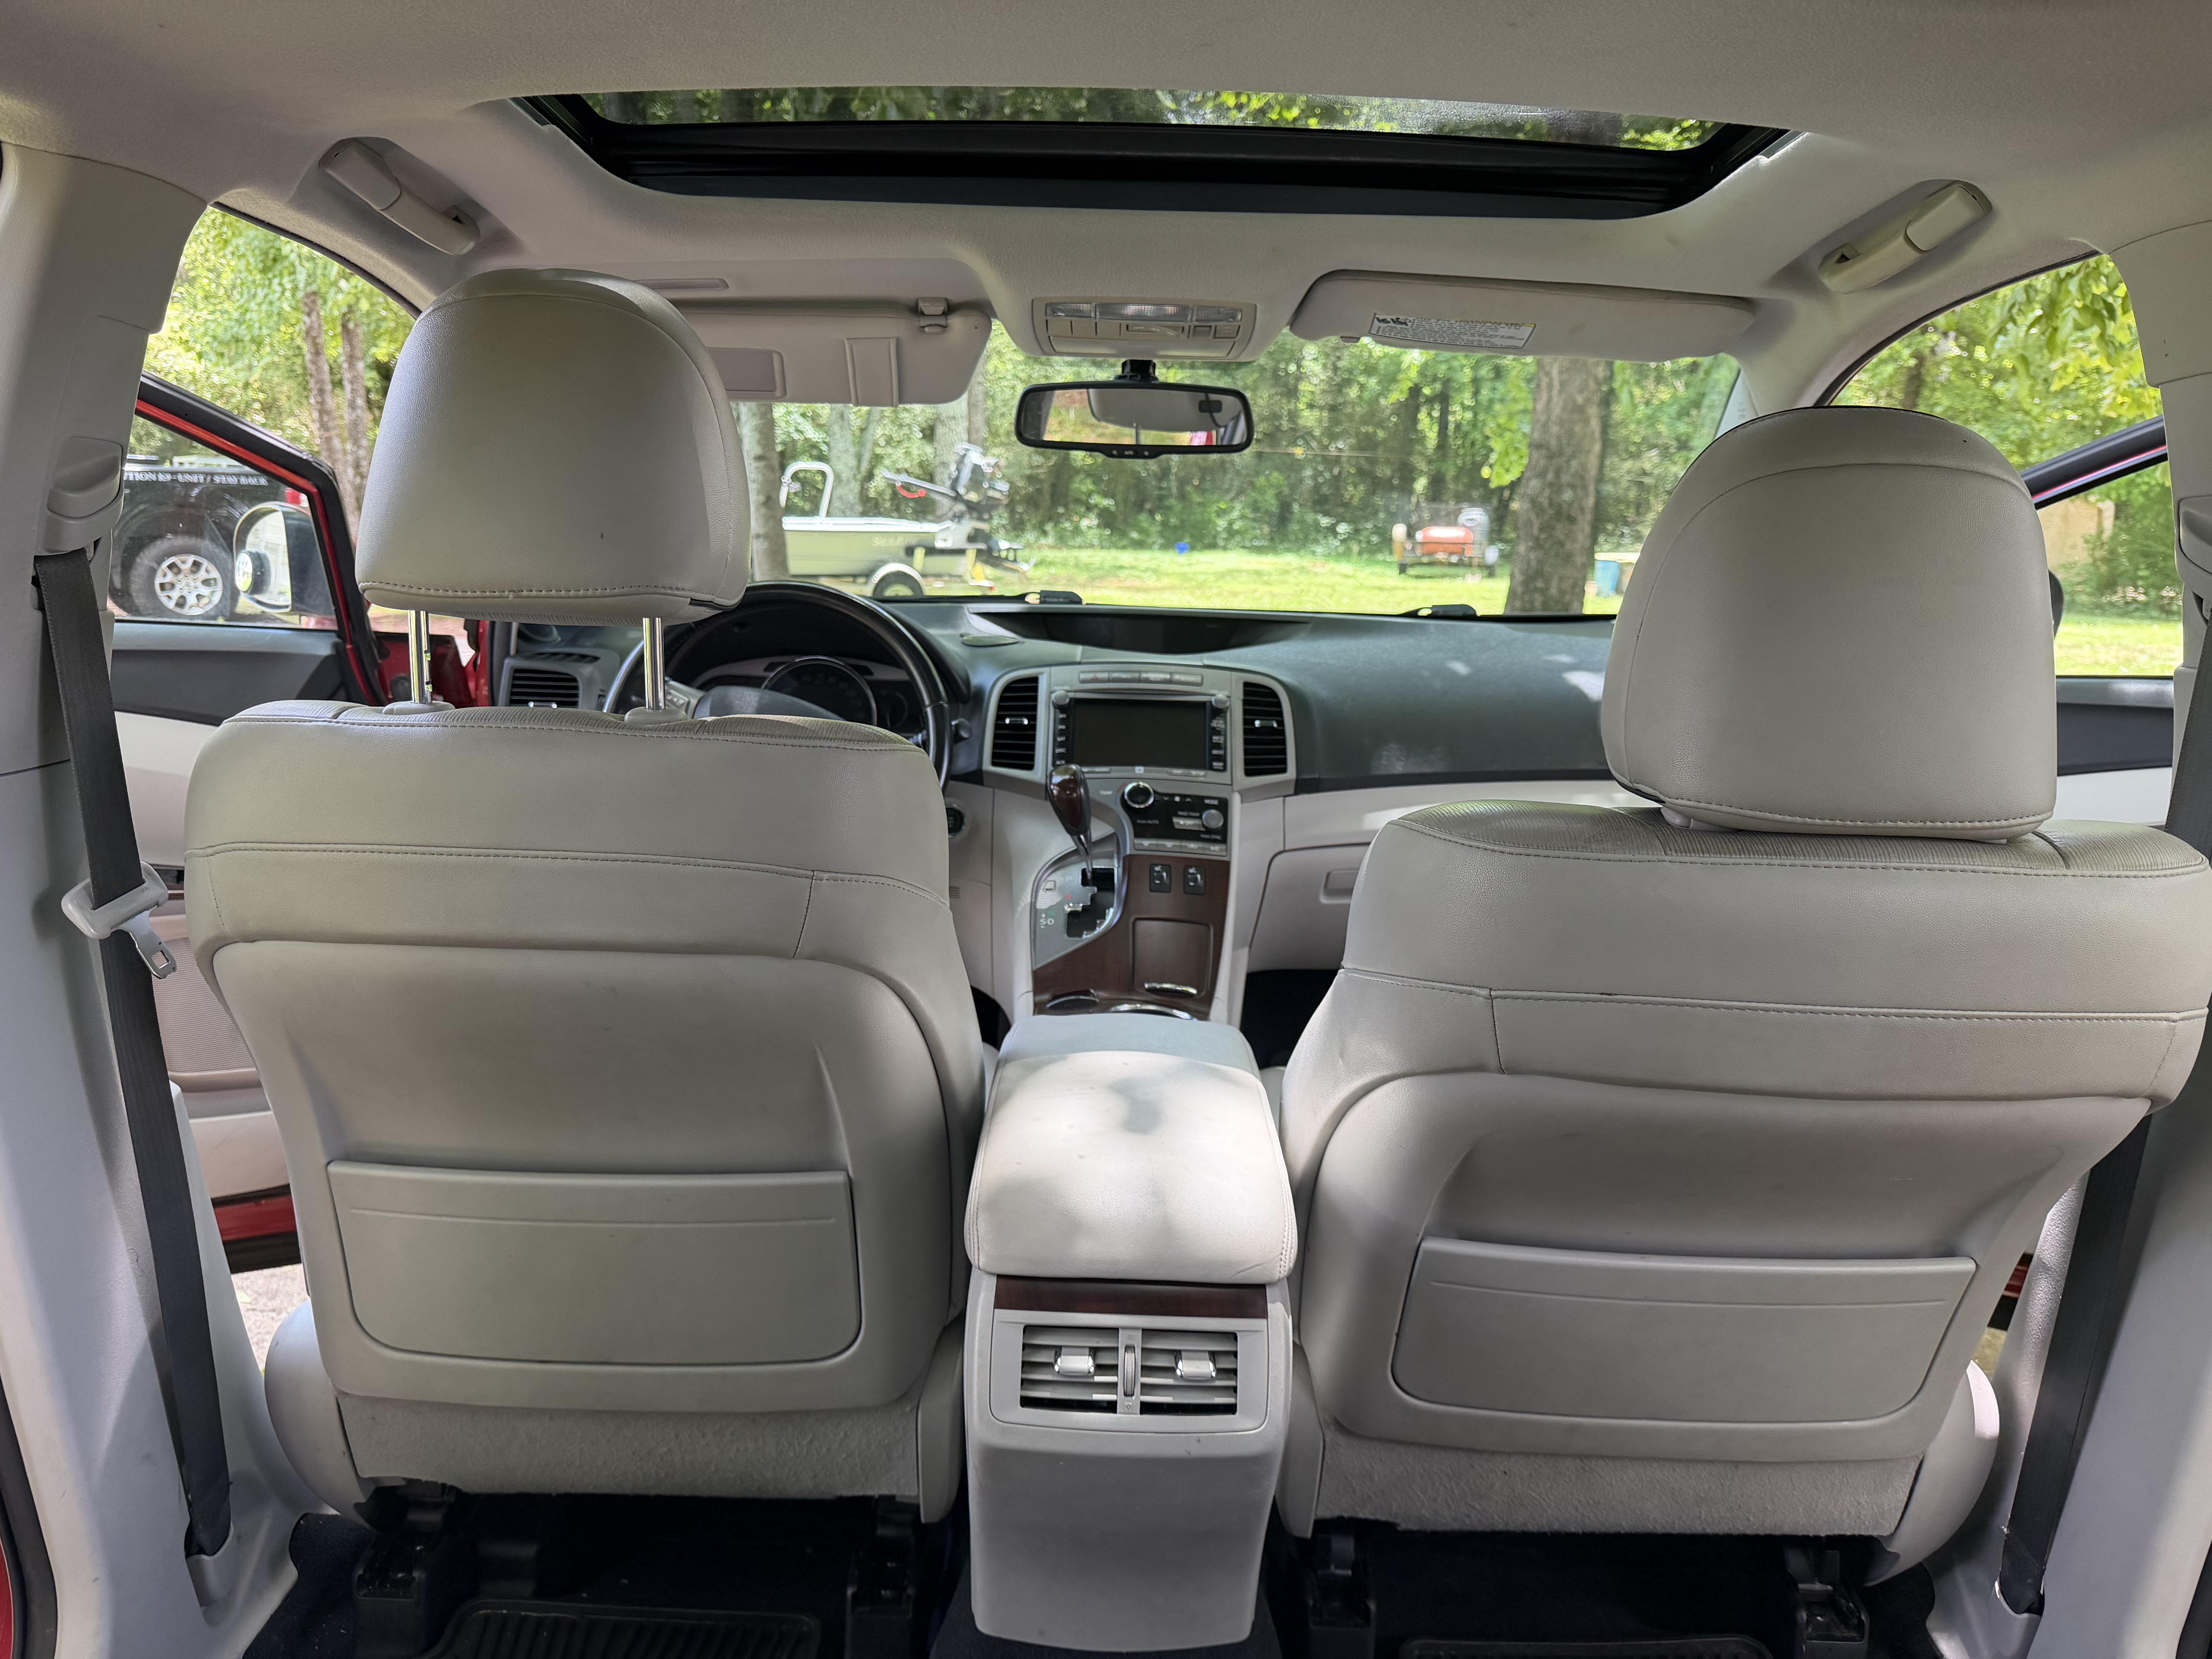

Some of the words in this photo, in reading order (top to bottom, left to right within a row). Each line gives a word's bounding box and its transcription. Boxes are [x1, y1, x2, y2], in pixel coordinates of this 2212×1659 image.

[124, 471, 157, 481] TION
[213, 474, 239, 484] STAY
[239, 475, 269, 486] BACK
